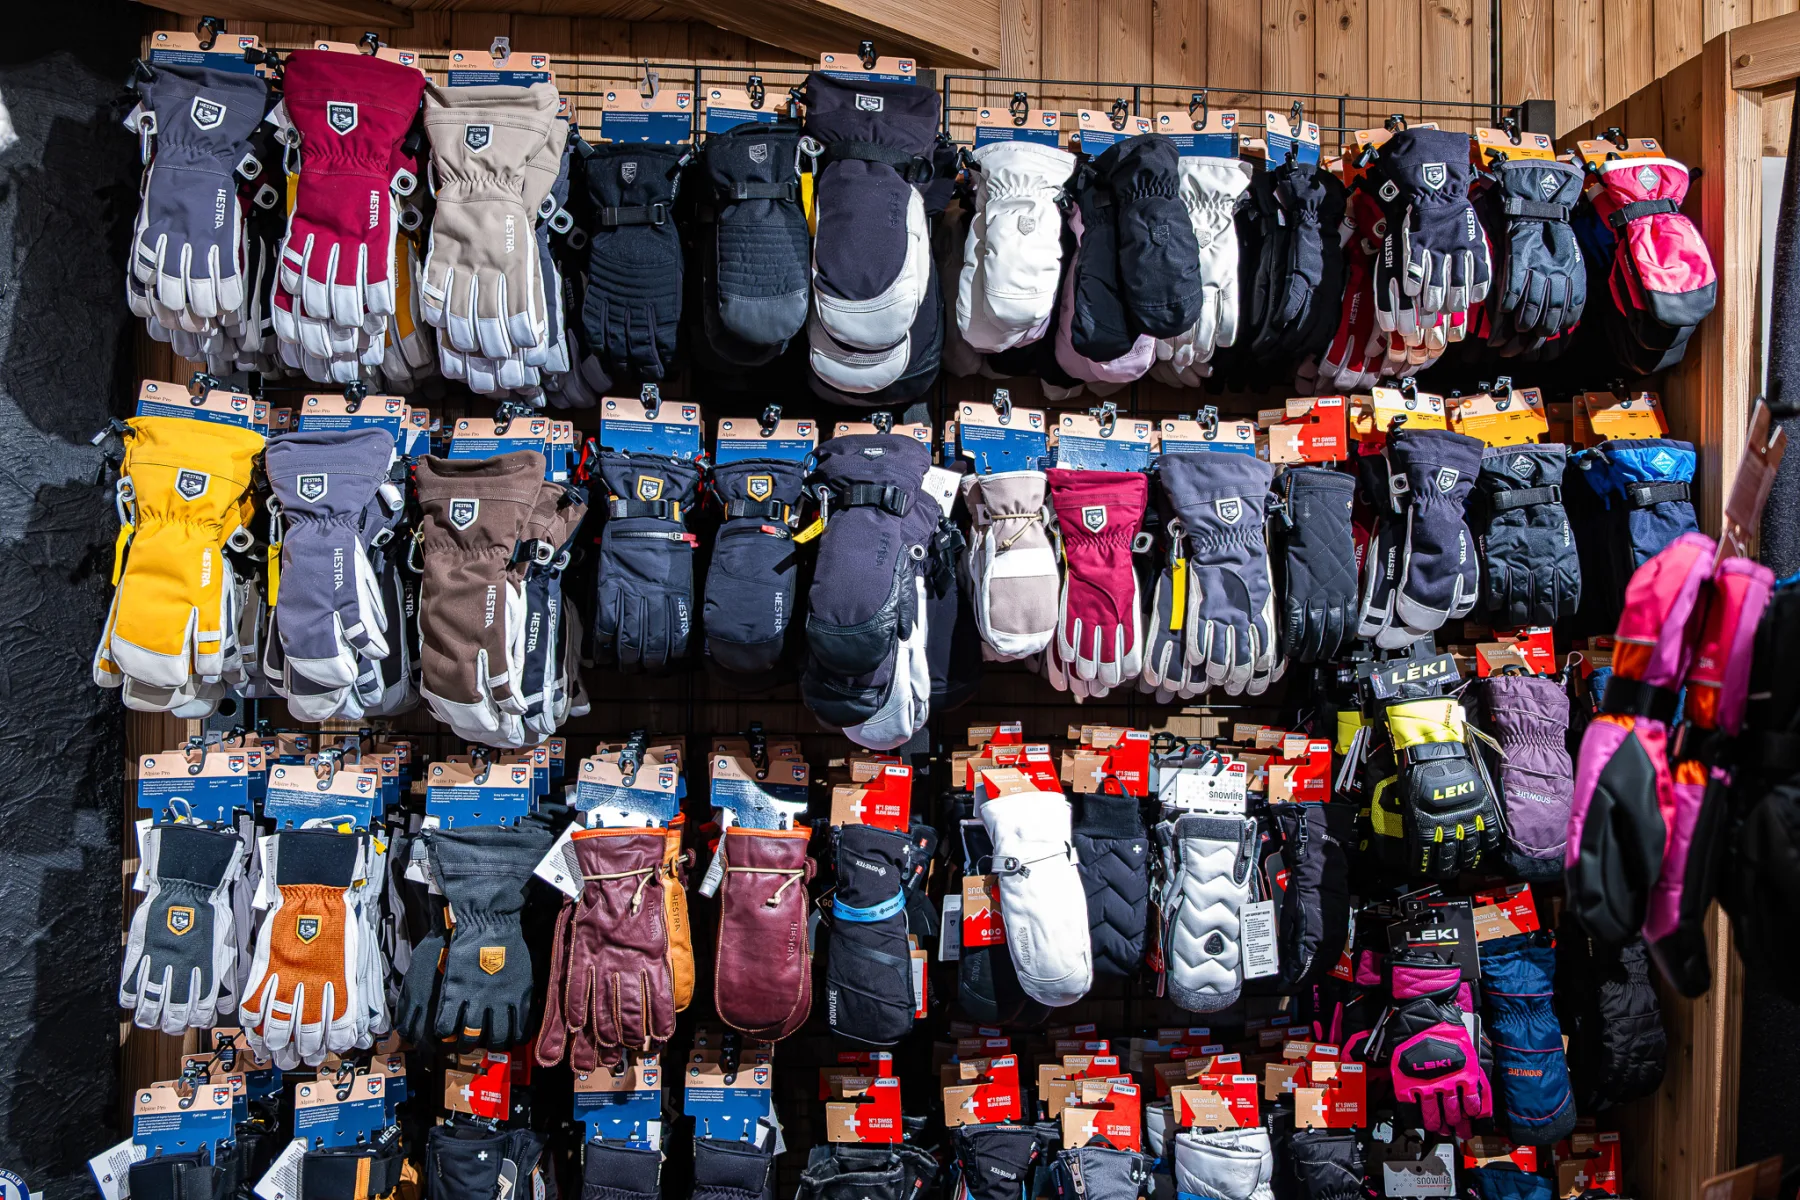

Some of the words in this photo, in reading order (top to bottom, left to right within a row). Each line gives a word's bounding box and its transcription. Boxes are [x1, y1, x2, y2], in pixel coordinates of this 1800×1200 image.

[199, 101, 219, 112] HESTRA
[214, 188, 227, 229] HESTRA
[369, 190, 380, 230] HESTRA
[505, 214, 515, 254] HESTRA
[1465, 207, 1477, 242] HESTRA
[1385, 233, 1394, 268] HESTRA
[1349, 291, 1362, 325] HESTRA
[144, 394, 160, 402] Alpine
[182, 472, 204, 480] HESTRA
[1458, 529, 1467, 565] HESTRA
[1563, 520, 1571, 548] HESTRA
[199, 547, 213, 588] HESTRA
[333, 547, 344, 591] HESTRA
[1386, 546, 1398, 581] HESTRA
[405, 580, 413, 619] HESTRA
[484, 584, 497, 629] HESTRA
[774, 592, 783, 635] HESTRA
[678, 597, 690, 637] HESTRA
[526, 612, 541, 654] HESTRA
[1390, 659, 1449, 685] LEKI
[143, 770, 160, 778] Alpine
[272, 780, 289, 788] Alpine
[1208, 790, 1244, 802] snowlife
[1433, 780, 1476, 801] LEKI
[856, 860, 880, 873] GORE-TEX
[1421, 846, 1430, 873] LEKI
[671, 894, 680, 932] HESTRA
[786, 921, 798, 962] HESTRA
[1406, 928, 1460, 942] LEKI
[1312, 984, 1320, 1013] LEKI
[1412, 1058, 1452, 1072] LEKI
[578, 1083, 593, 1091] Alpine
[139, 1105, 156, 1113] Alpine
[299, 1098, 316, 1106] Alpine
[6, 1170, 23, 1187] BALM
[1416, 1175, 1452, 1186] snowlife
